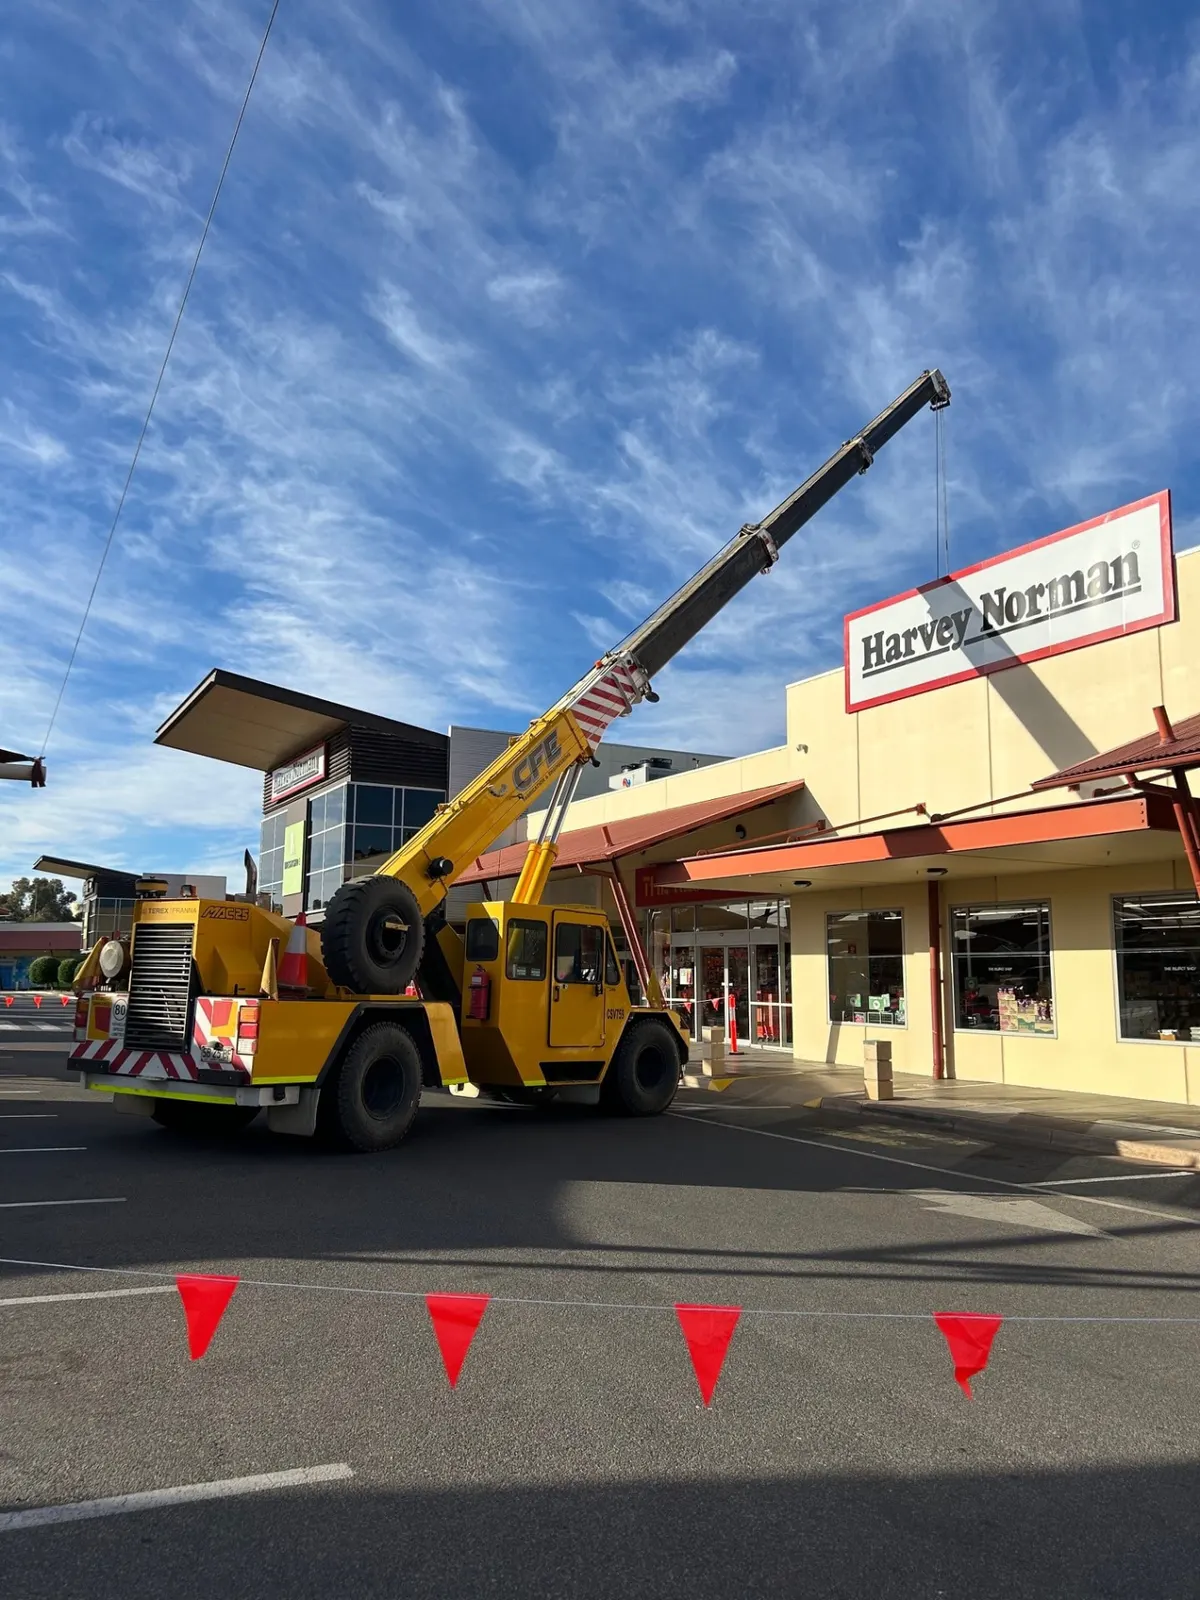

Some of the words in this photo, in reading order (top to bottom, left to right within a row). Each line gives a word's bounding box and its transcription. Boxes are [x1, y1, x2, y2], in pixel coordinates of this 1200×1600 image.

[862, 608, 973, 670] Harvey
[980, 552, 1141, 631] Norman
[513, 727, 562, 791] CFE
[115, 1004, 126, 1016] 80
